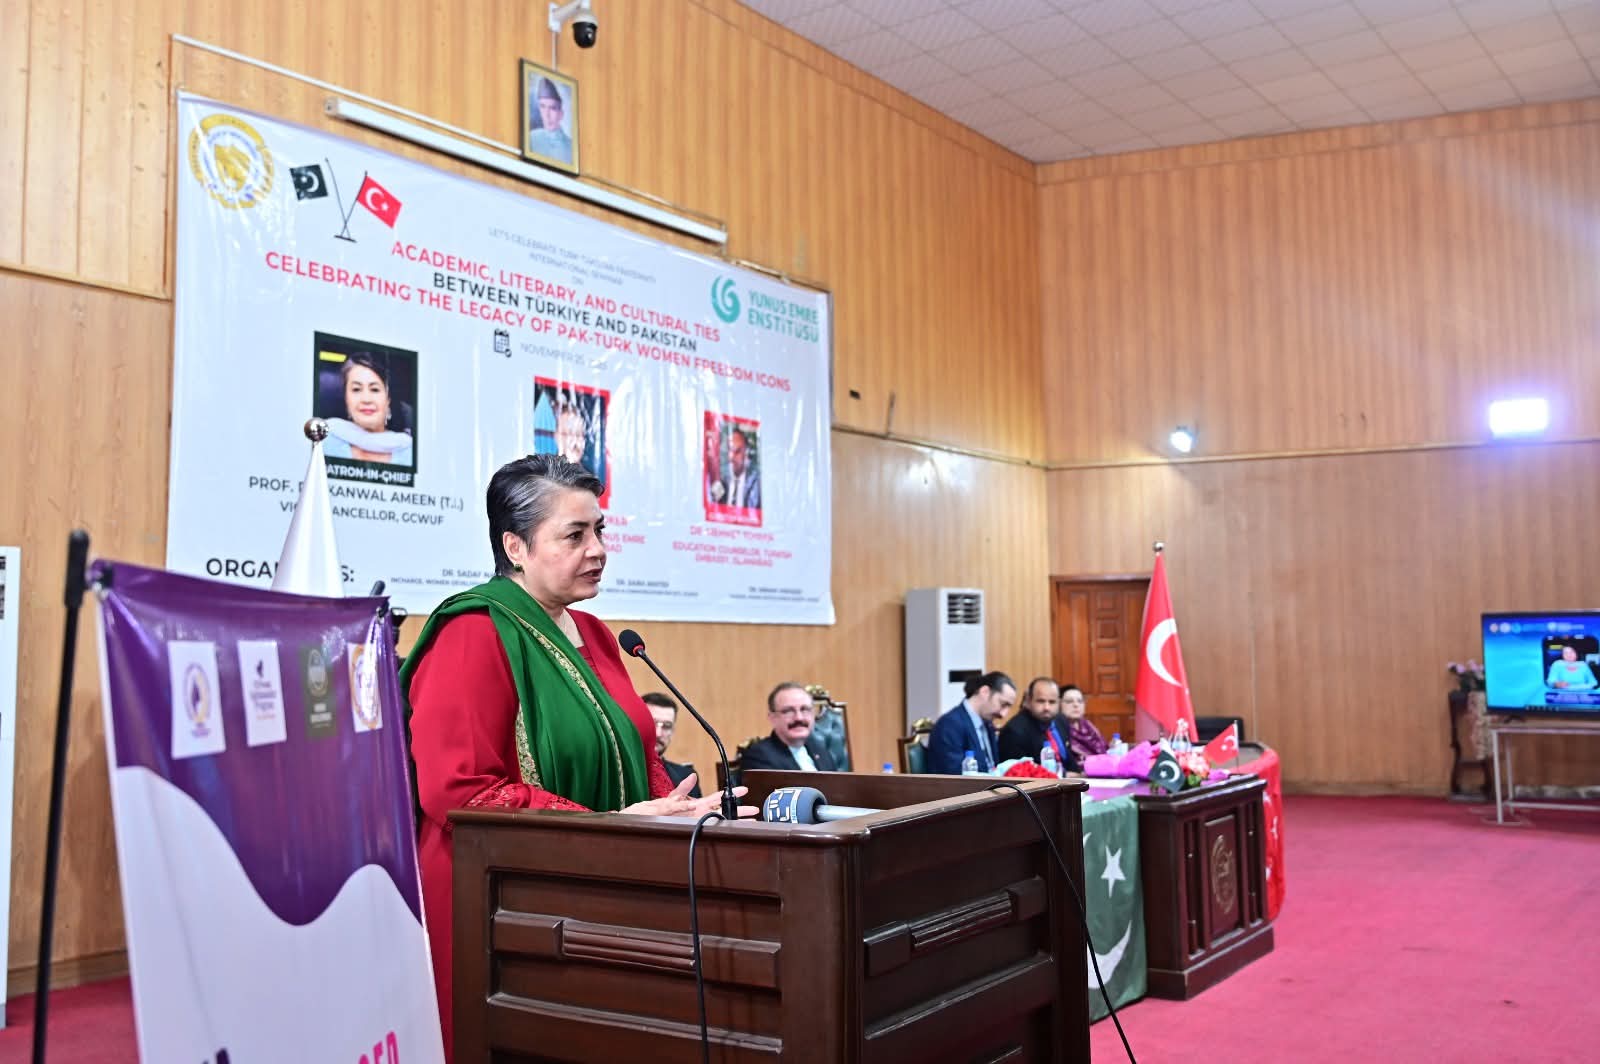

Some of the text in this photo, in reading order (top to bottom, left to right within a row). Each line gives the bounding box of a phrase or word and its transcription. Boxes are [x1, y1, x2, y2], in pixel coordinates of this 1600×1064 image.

[392, 240, 721, 343] ACADEMIC, LITERARY, AND CULTURAL TIES
[748, 290, 820, 325] YUNUS EMRE
[265, 251, 412, 301] CELEBRATING
[417, 288, 453, 312] THE
[460, 298, 526, 328] LEGACY
[531, 318, 552, 335] OF
[558, 326, 632, 354] PAK-TURK
[636, 344, 691, 368] WOMEN
[756, 373, 792, 392] ICONS
[434, 272, 520, 308] BETWEEN
[595, 315, 628, 335] AND
[632, 326, 698, 352] PAKISTAN
[248, 476, 294, 494] PROF.
[390, 492, 437, 508] AMEEN
[327, 464, 412, 485] ATRON-IN-CHIEF
[402, 512, 445, 526] GCWUF
